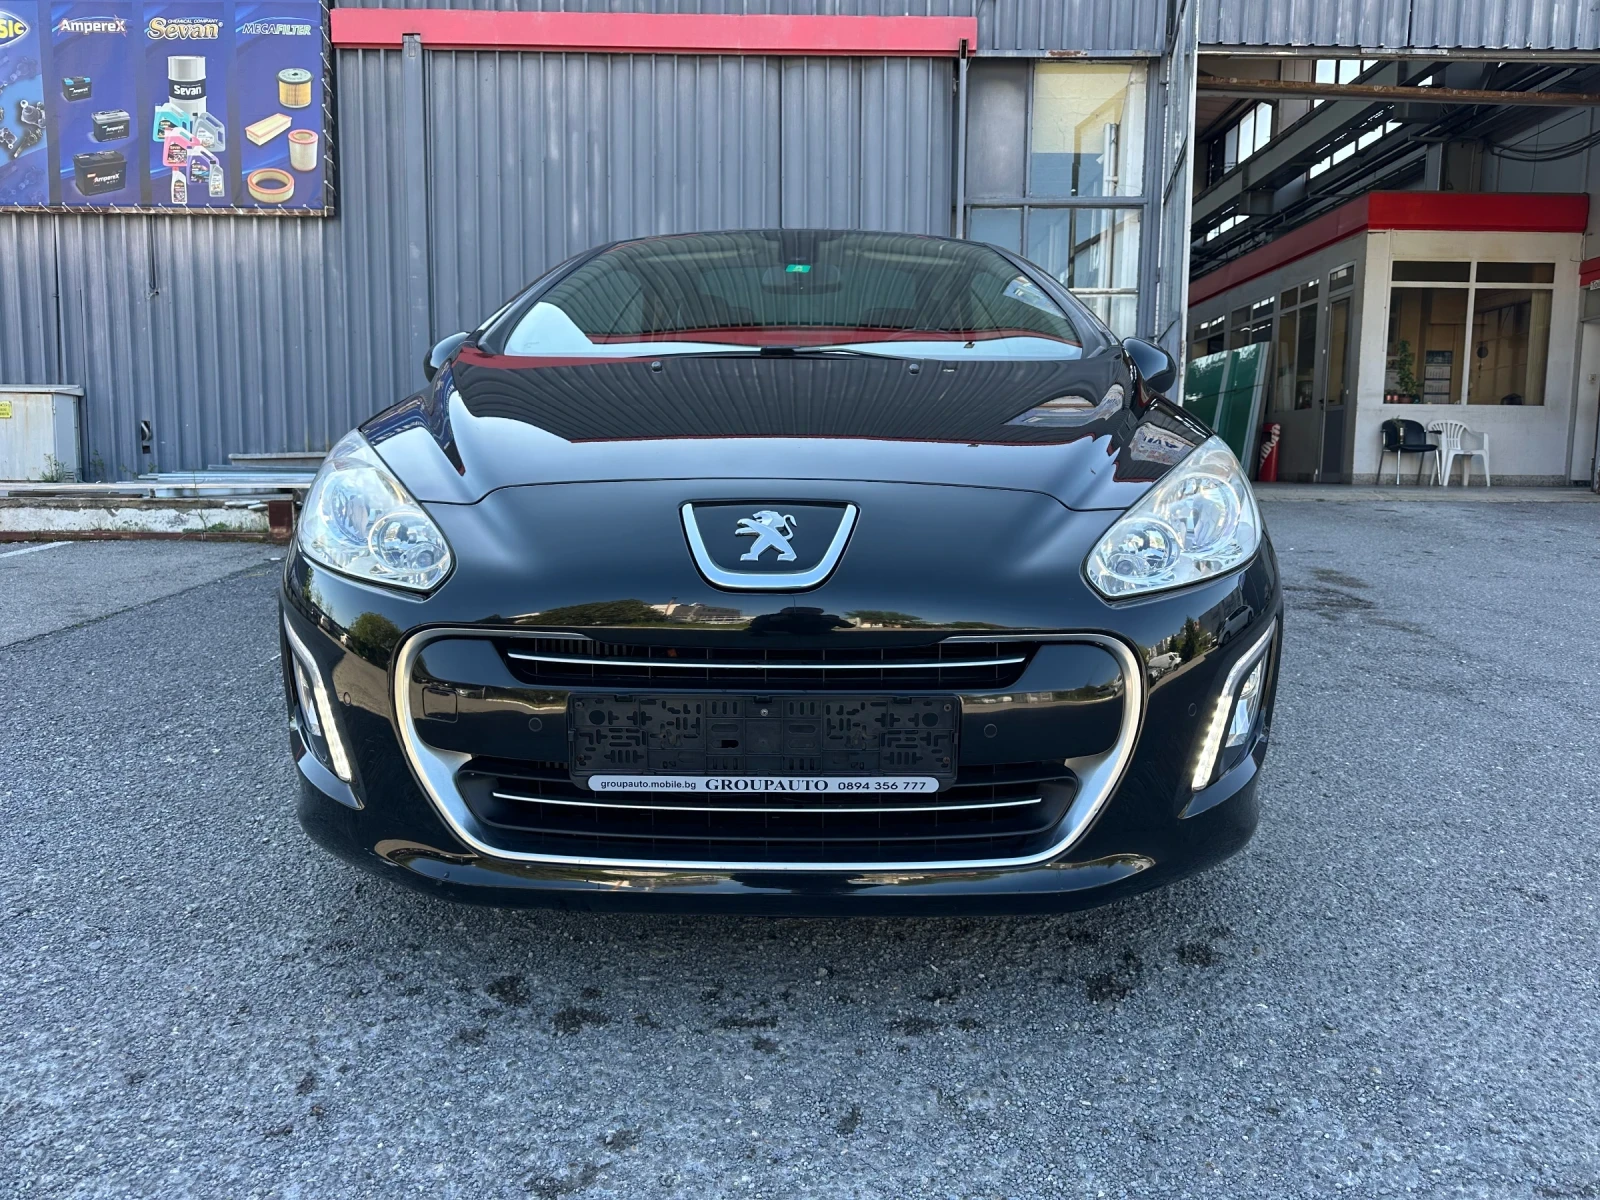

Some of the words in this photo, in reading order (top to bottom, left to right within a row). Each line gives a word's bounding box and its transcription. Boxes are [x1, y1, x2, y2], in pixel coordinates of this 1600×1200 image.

[59, 17, 127, 35] AmpereX
[173, 84, 202, 96] Sevan
[94, 173, 121, 183] AmpereX
[600, 780, 697, 790] groupauto.mobile.bg
[705, 778, 829, 791] GROUPAUTO
[837, 781, 870, 790] 0894
[874, 781, 899, 790] 356
[903, 781, 927, 790] 777
